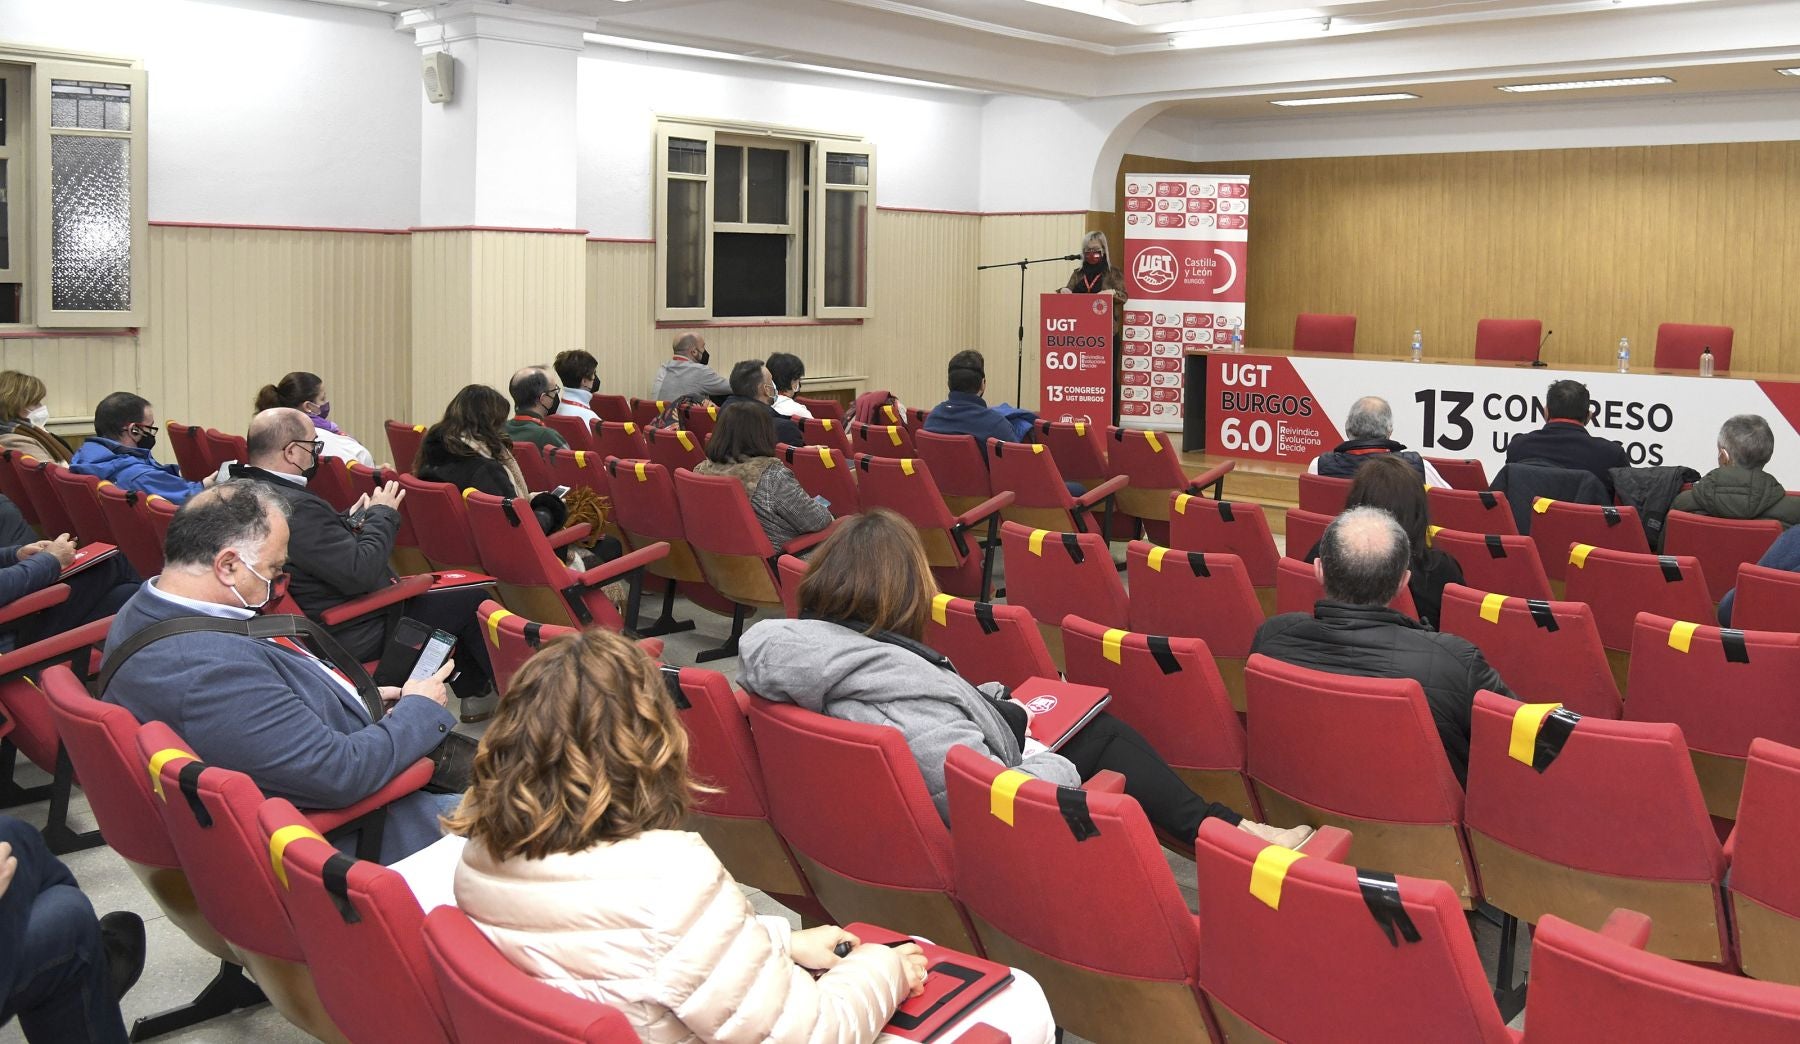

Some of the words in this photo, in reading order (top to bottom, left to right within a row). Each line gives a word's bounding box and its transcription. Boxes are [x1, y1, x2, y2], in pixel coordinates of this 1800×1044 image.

[1139, 255, 1171, 273] UGT
[1184, 258, 1216, 266] Castilla
[1184, 269, 1190, 277] y
[1192, 268, 1212, 276] León
[1046, 318, 1077, 332] UGT
[1047, 336, 1105, 348] BURGOS
[1046, 352, 1078, 370] 6.0
[1221, 362, 1272, 388] UGT
[1046, 386, 1063, 402] 13
[1221, 392, 1312, 417] BURGOS
[1414, 389, 1474, 451] 13
[1482, 392, 1673, 432] CONRESO
[1220, 417, 1272, 452] 6.0
[1280, 426, 1319, 437] Reivindica
[1280, 434, 1321, 446] Evoluciona
[1280, 443, 1306, 452] Decide
